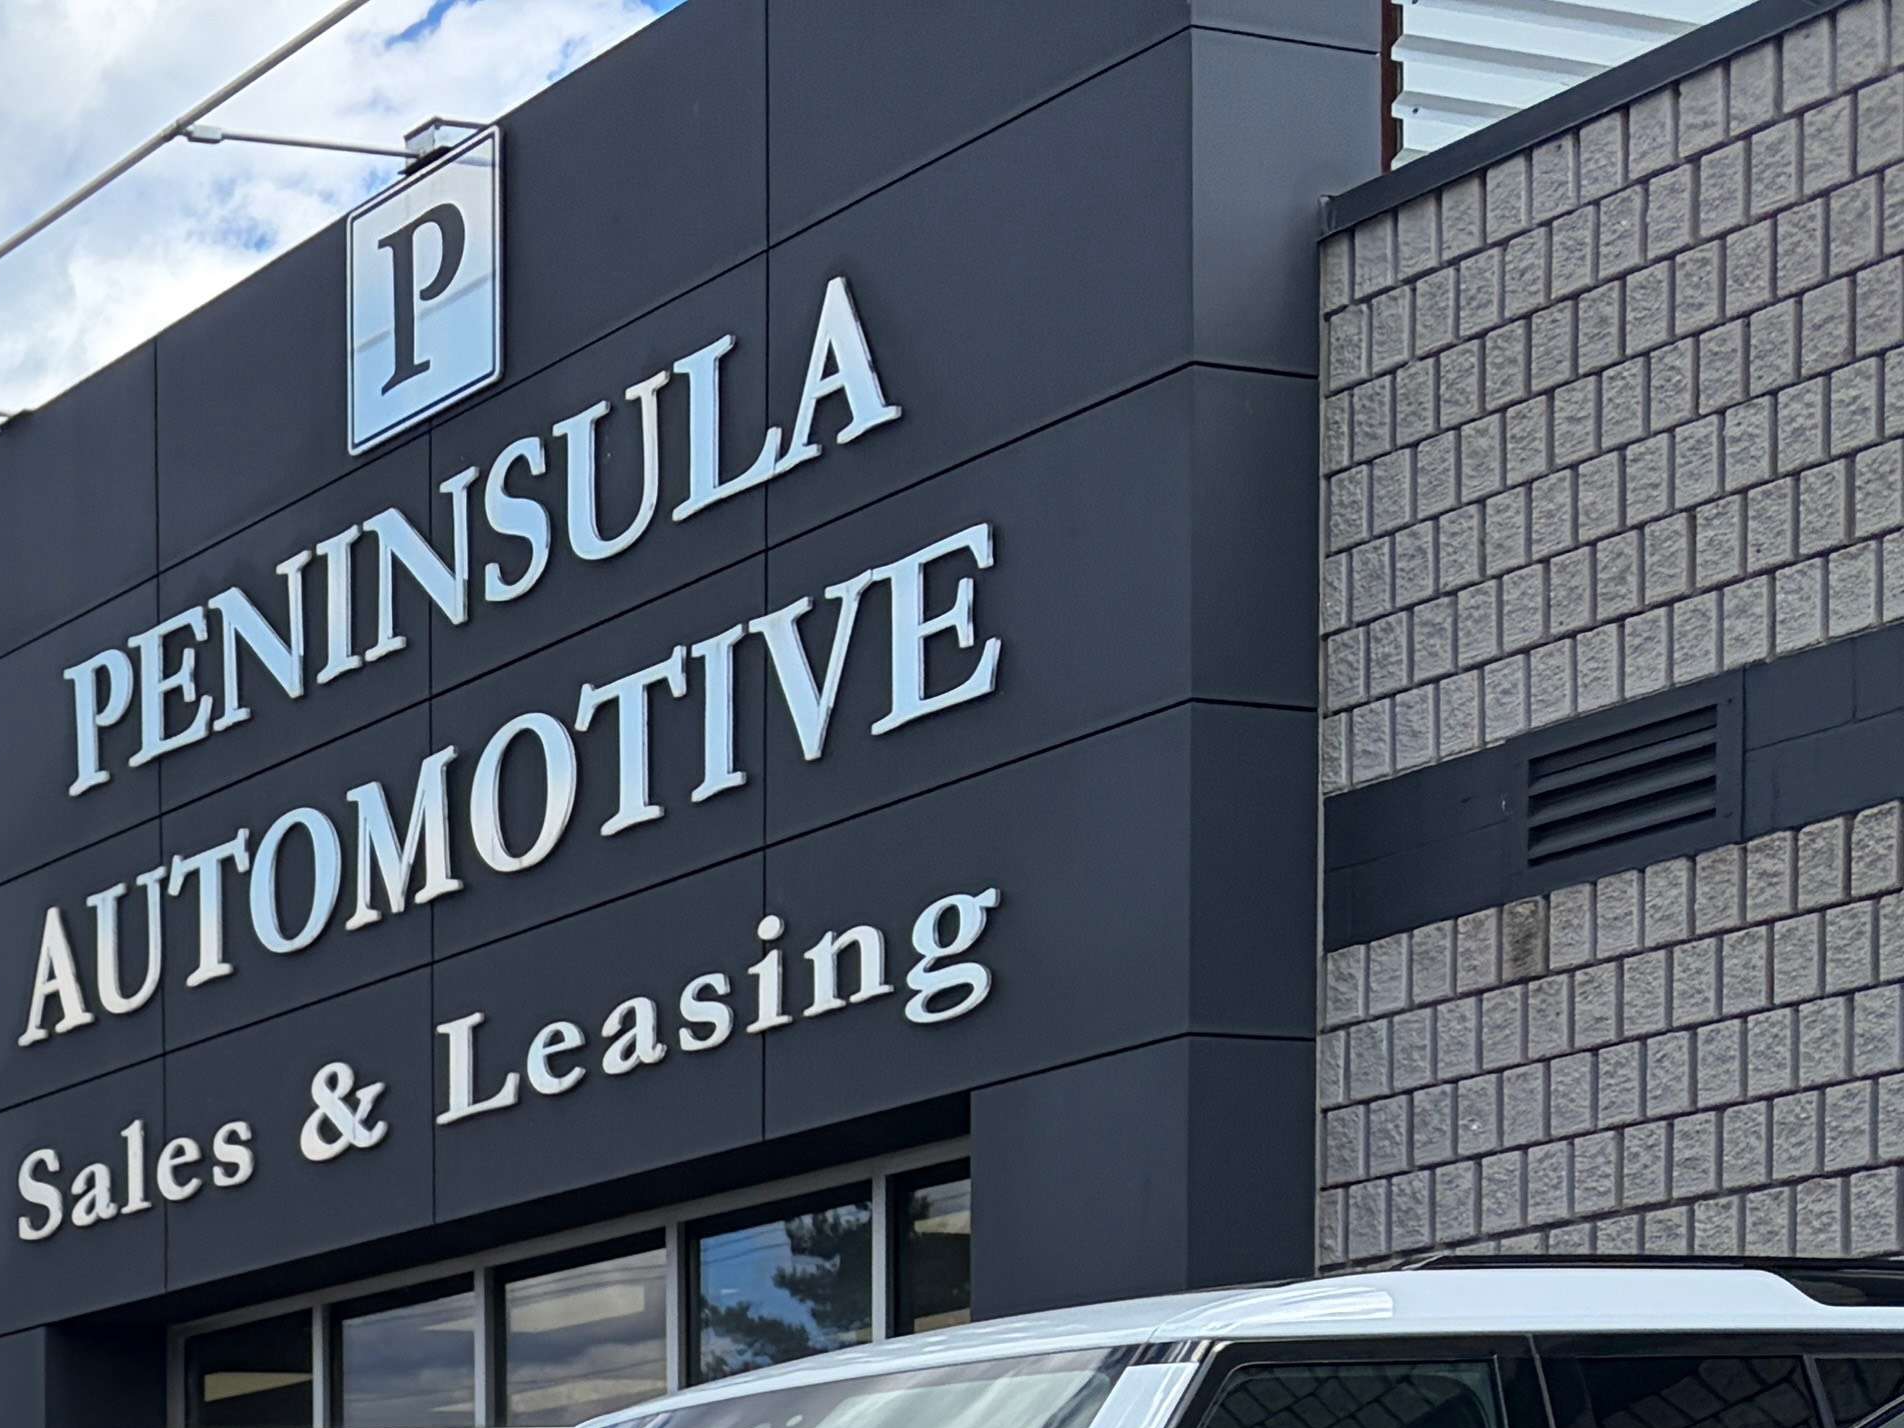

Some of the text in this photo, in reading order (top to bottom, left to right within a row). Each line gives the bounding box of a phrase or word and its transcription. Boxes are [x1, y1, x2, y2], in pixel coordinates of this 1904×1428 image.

[378, 203, 465, 396] P
[64, 277, 901, 797] PENINSULA
[18, 523, 1001, 1046] AUTOMOTIVE
[19, 887, 998, 1240] Sales & Leasing
